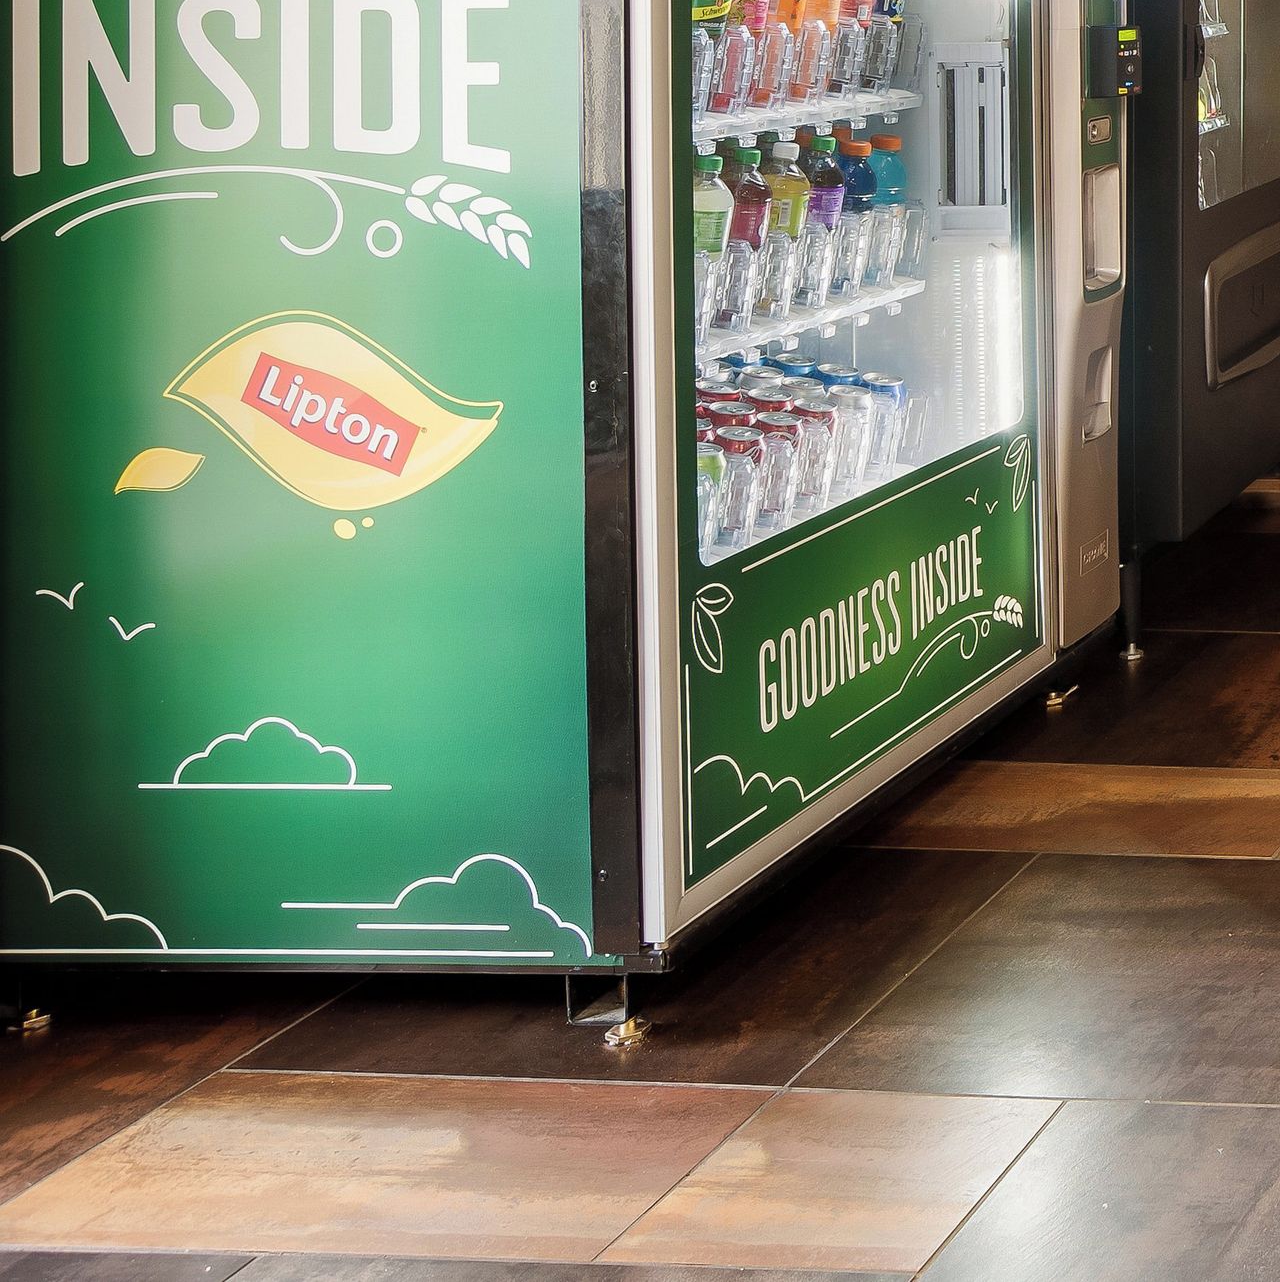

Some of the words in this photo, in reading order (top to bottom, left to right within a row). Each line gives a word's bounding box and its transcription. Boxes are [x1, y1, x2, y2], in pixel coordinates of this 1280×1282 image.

[257, 364, 401, 463] Lipton
[757, 570, 902, 733] GOODNESS
[910, 525, 985, 640] INSIDE
